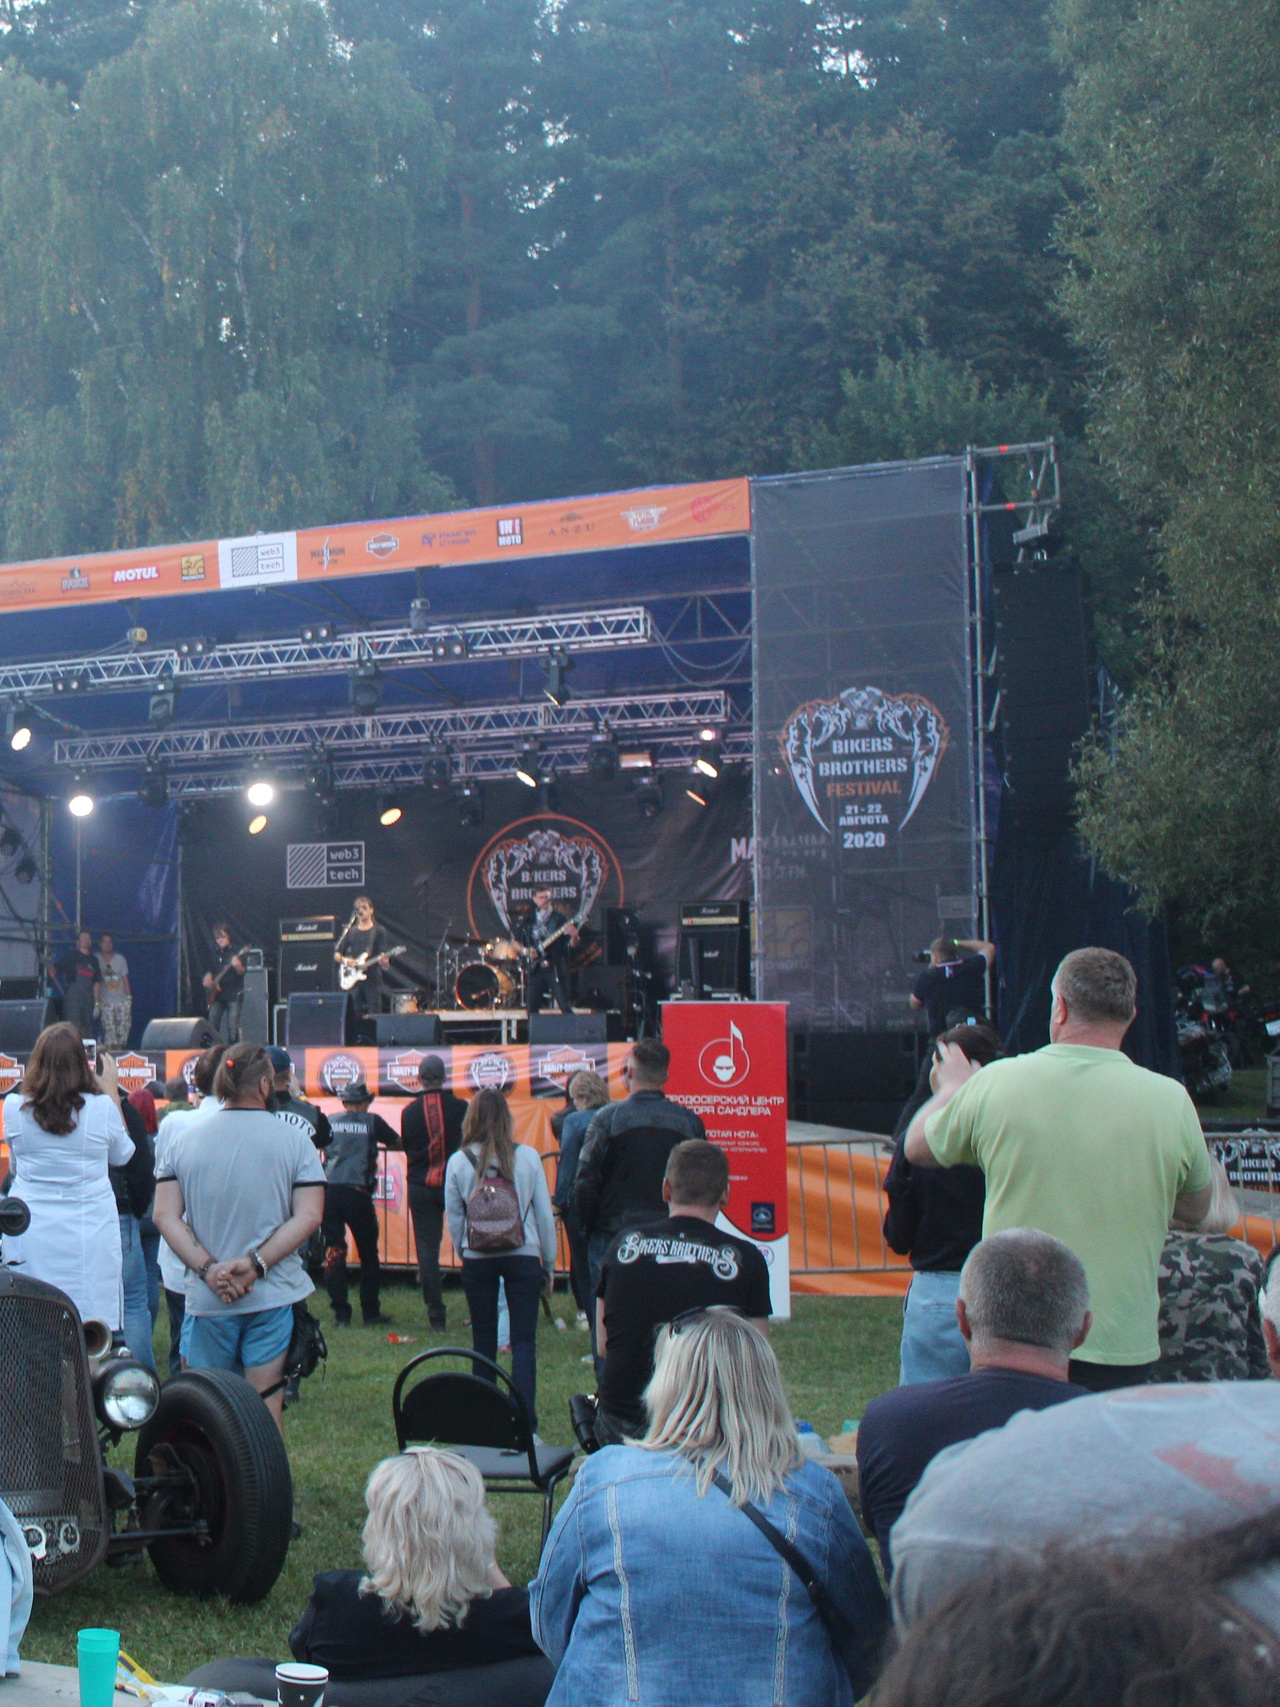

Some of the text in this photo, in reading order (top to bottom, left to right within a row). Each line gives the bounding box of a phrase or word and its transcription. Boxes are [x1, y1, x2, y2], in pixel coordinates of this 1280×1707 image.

[498, 535, 522, 546] MOTO
[260, 547, 281, 557] web3
[260, 560, 281, 571] tech
[113, 566, 159, 582] MOTUL
[832, 736, 893, 755] BIKERS
[818, 758, 908, 777] BROTHERS
[827, 780, 902, 798] FESTIVAL
[845, 805, 858, 815] 21
[867, 803, 882, 814] 22
[839, 814, 889, 826] АВГУСТА
[843, 832, 886, 849] 2020
[329, 848, 359, 861] web3
[329, 867, 359, 881] tech
[521, 869, 567, 883] BKERS
[511, 886, 577, 900] BROERS
[117, 1067, 152, 1078] RLEY-DAVIDSON
[392, 1066, 419, 1076] HARLEY-DA
[752, 1096, 785, 1106] ЦЕНТР
[717, 1106, 772, 1117] САНДЛЕРА
